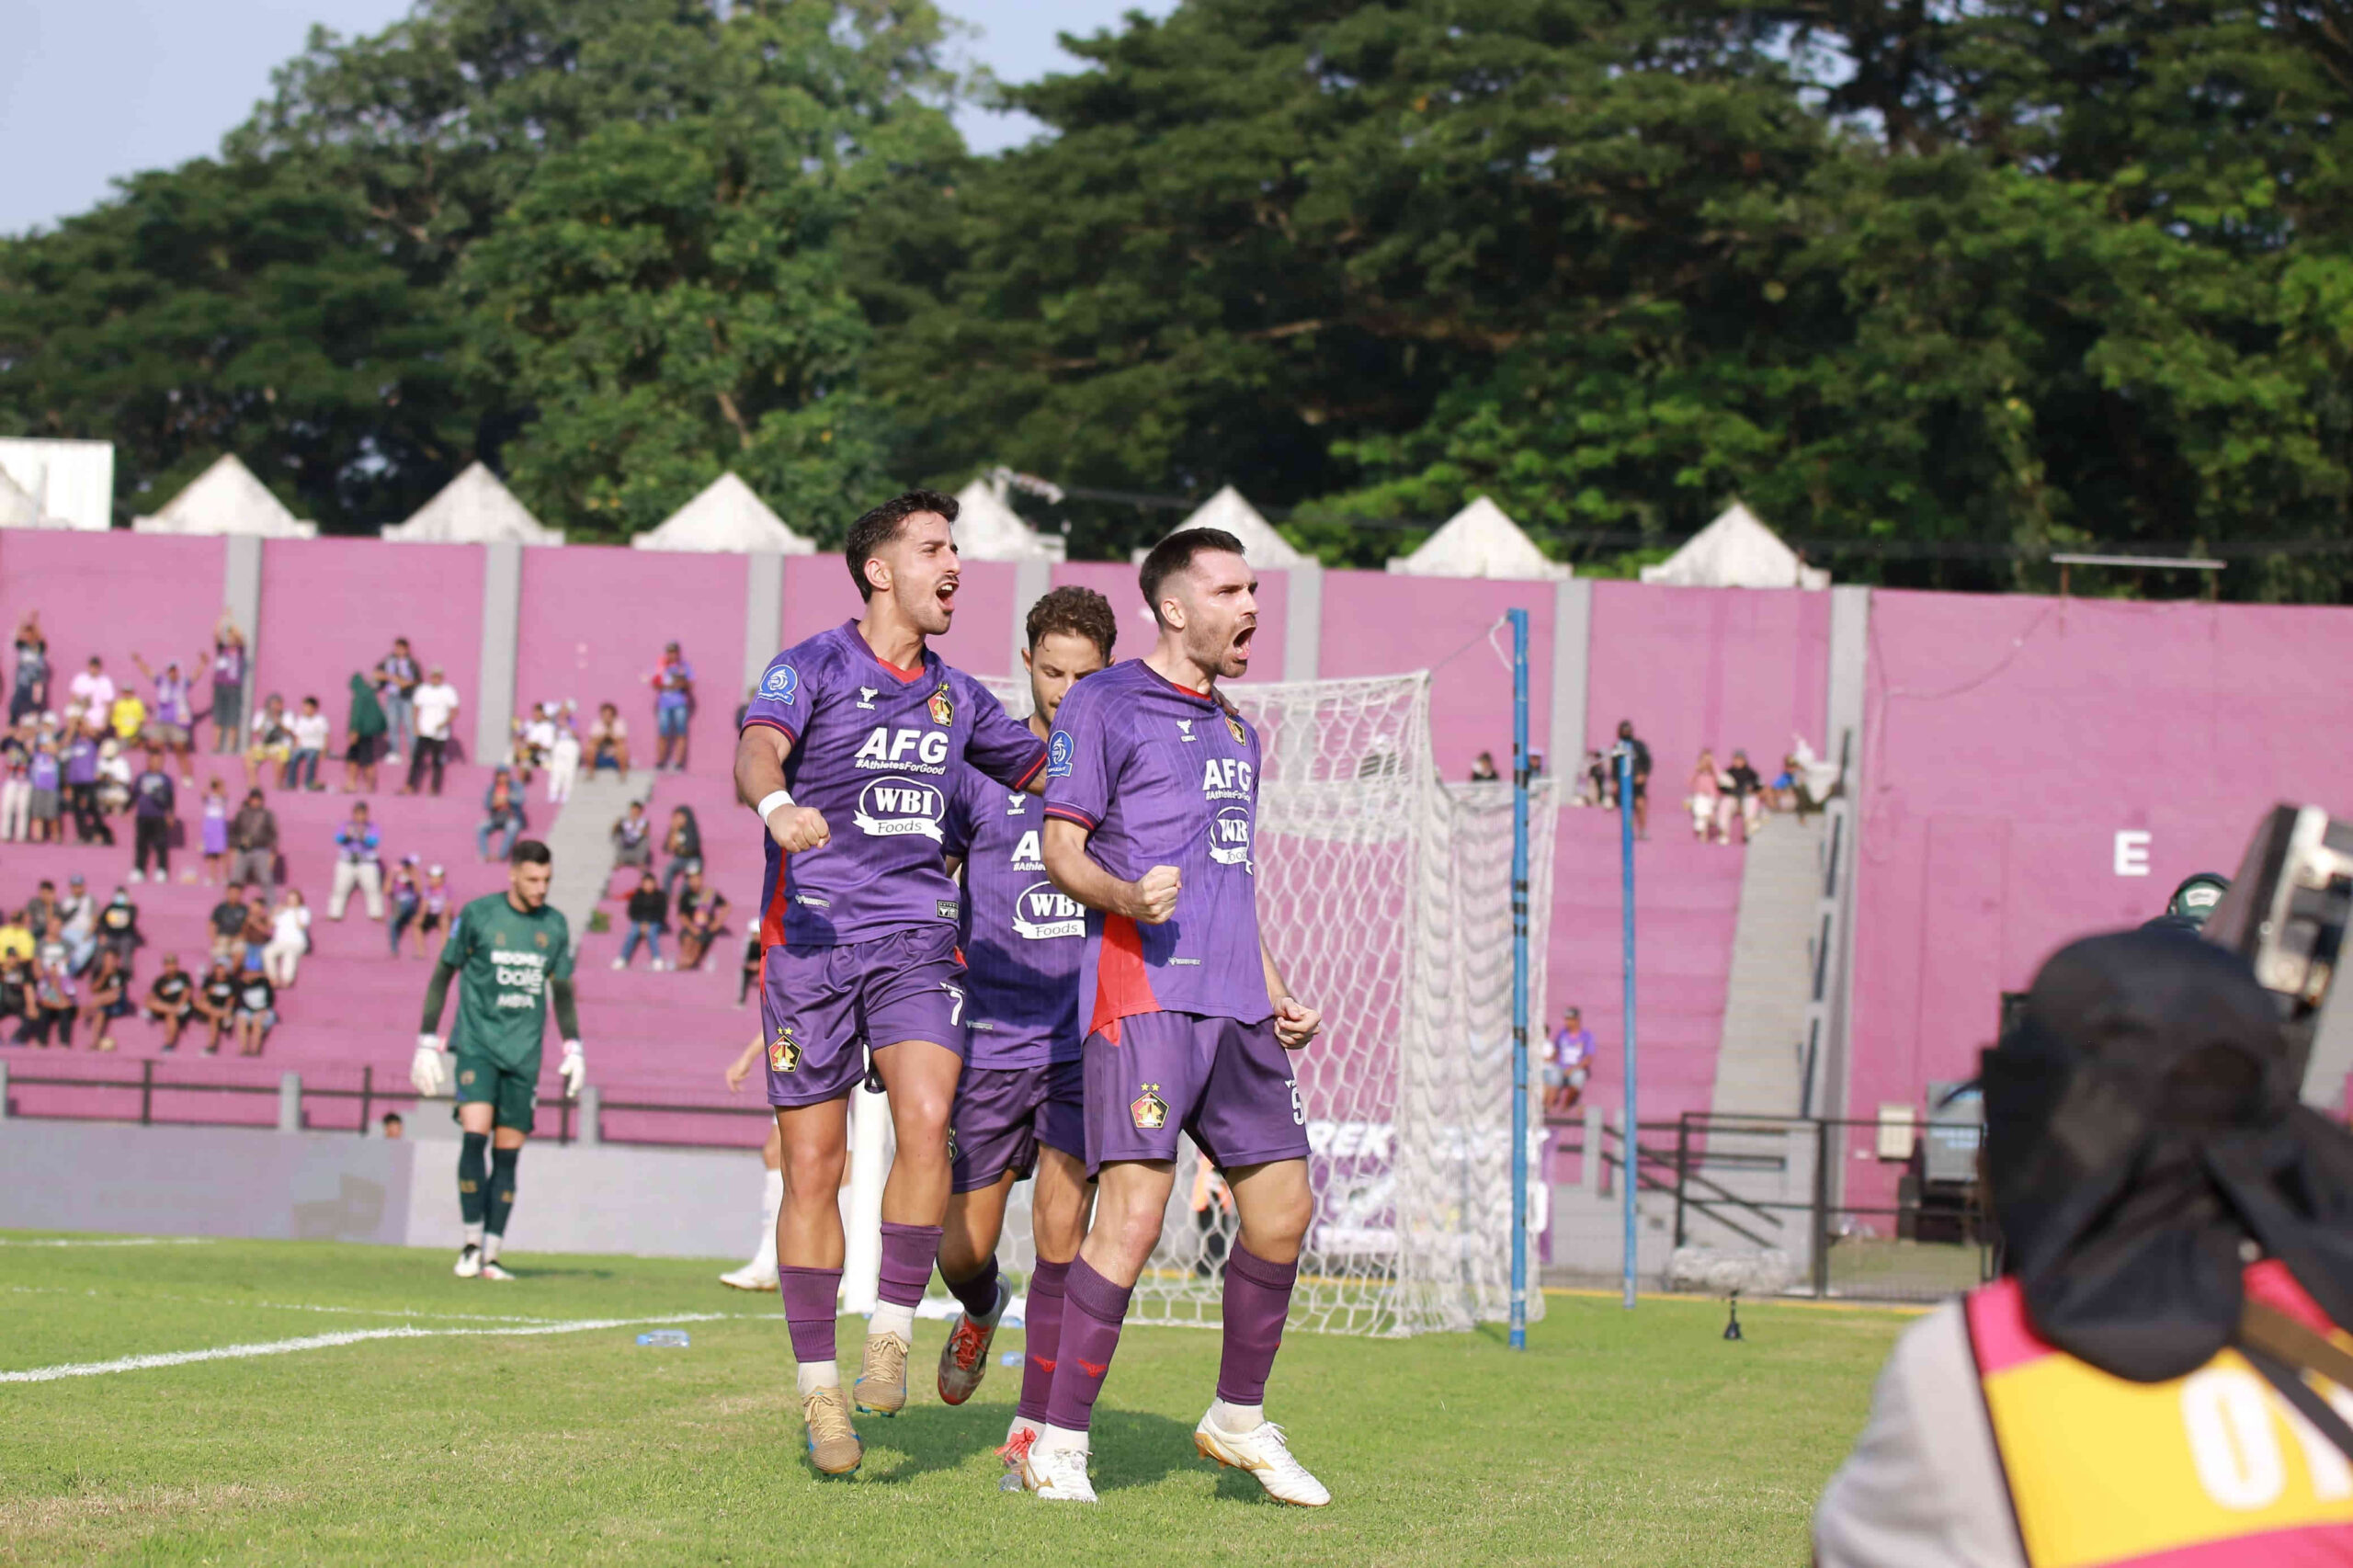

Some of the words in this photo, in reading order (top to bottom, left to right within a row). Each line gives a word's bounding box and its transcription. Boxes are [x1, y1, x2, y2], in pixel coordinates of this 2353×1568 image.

[854, 726, 949, 764] AFG
[855, 758, 946, 775] #AthletesForGood
[1202, 758, 1252, 792] AFG
[874, 787, 934, 816] WBI
[878, 819, 922, 834] Foods
[1217, 818, 1249, 842] WB
[2114, 830, 2152, 876] E
[1028, 893, 1086, 917] WBI
[1036, 923, 1078, 937] Foods
[949, 990, 963, 1027] 7
[1291, 1086, 1304, 1126] 5
